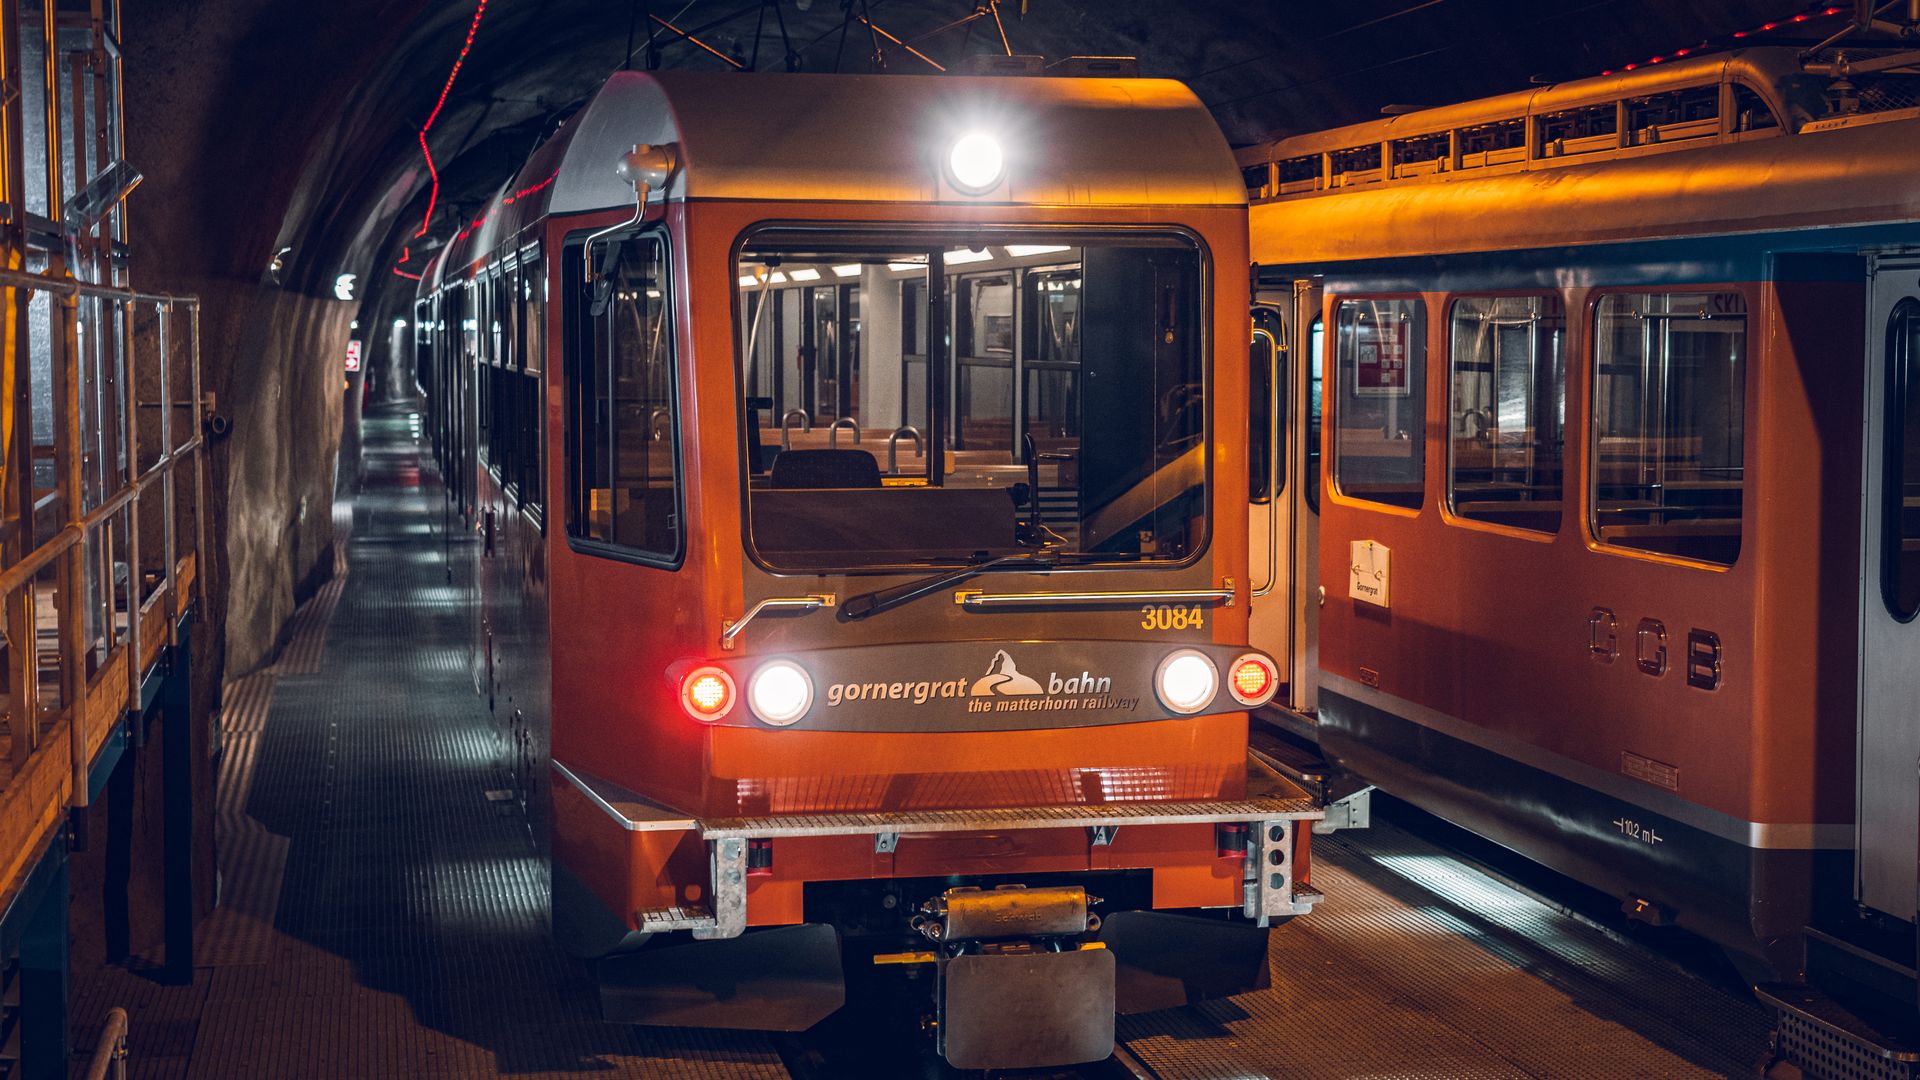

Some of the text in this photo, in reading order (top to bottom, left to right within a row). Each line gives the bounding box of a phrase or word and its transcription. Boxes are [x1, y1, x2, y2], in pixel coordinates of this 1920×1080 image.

[1356, 581, 1378, 596] Gornergrat
[1141, 604, 1204, 630] 3084
[827, 671, 1112, 707] gornergrat bahn
[968, 695, 1139, 713] the matterhorn railway
